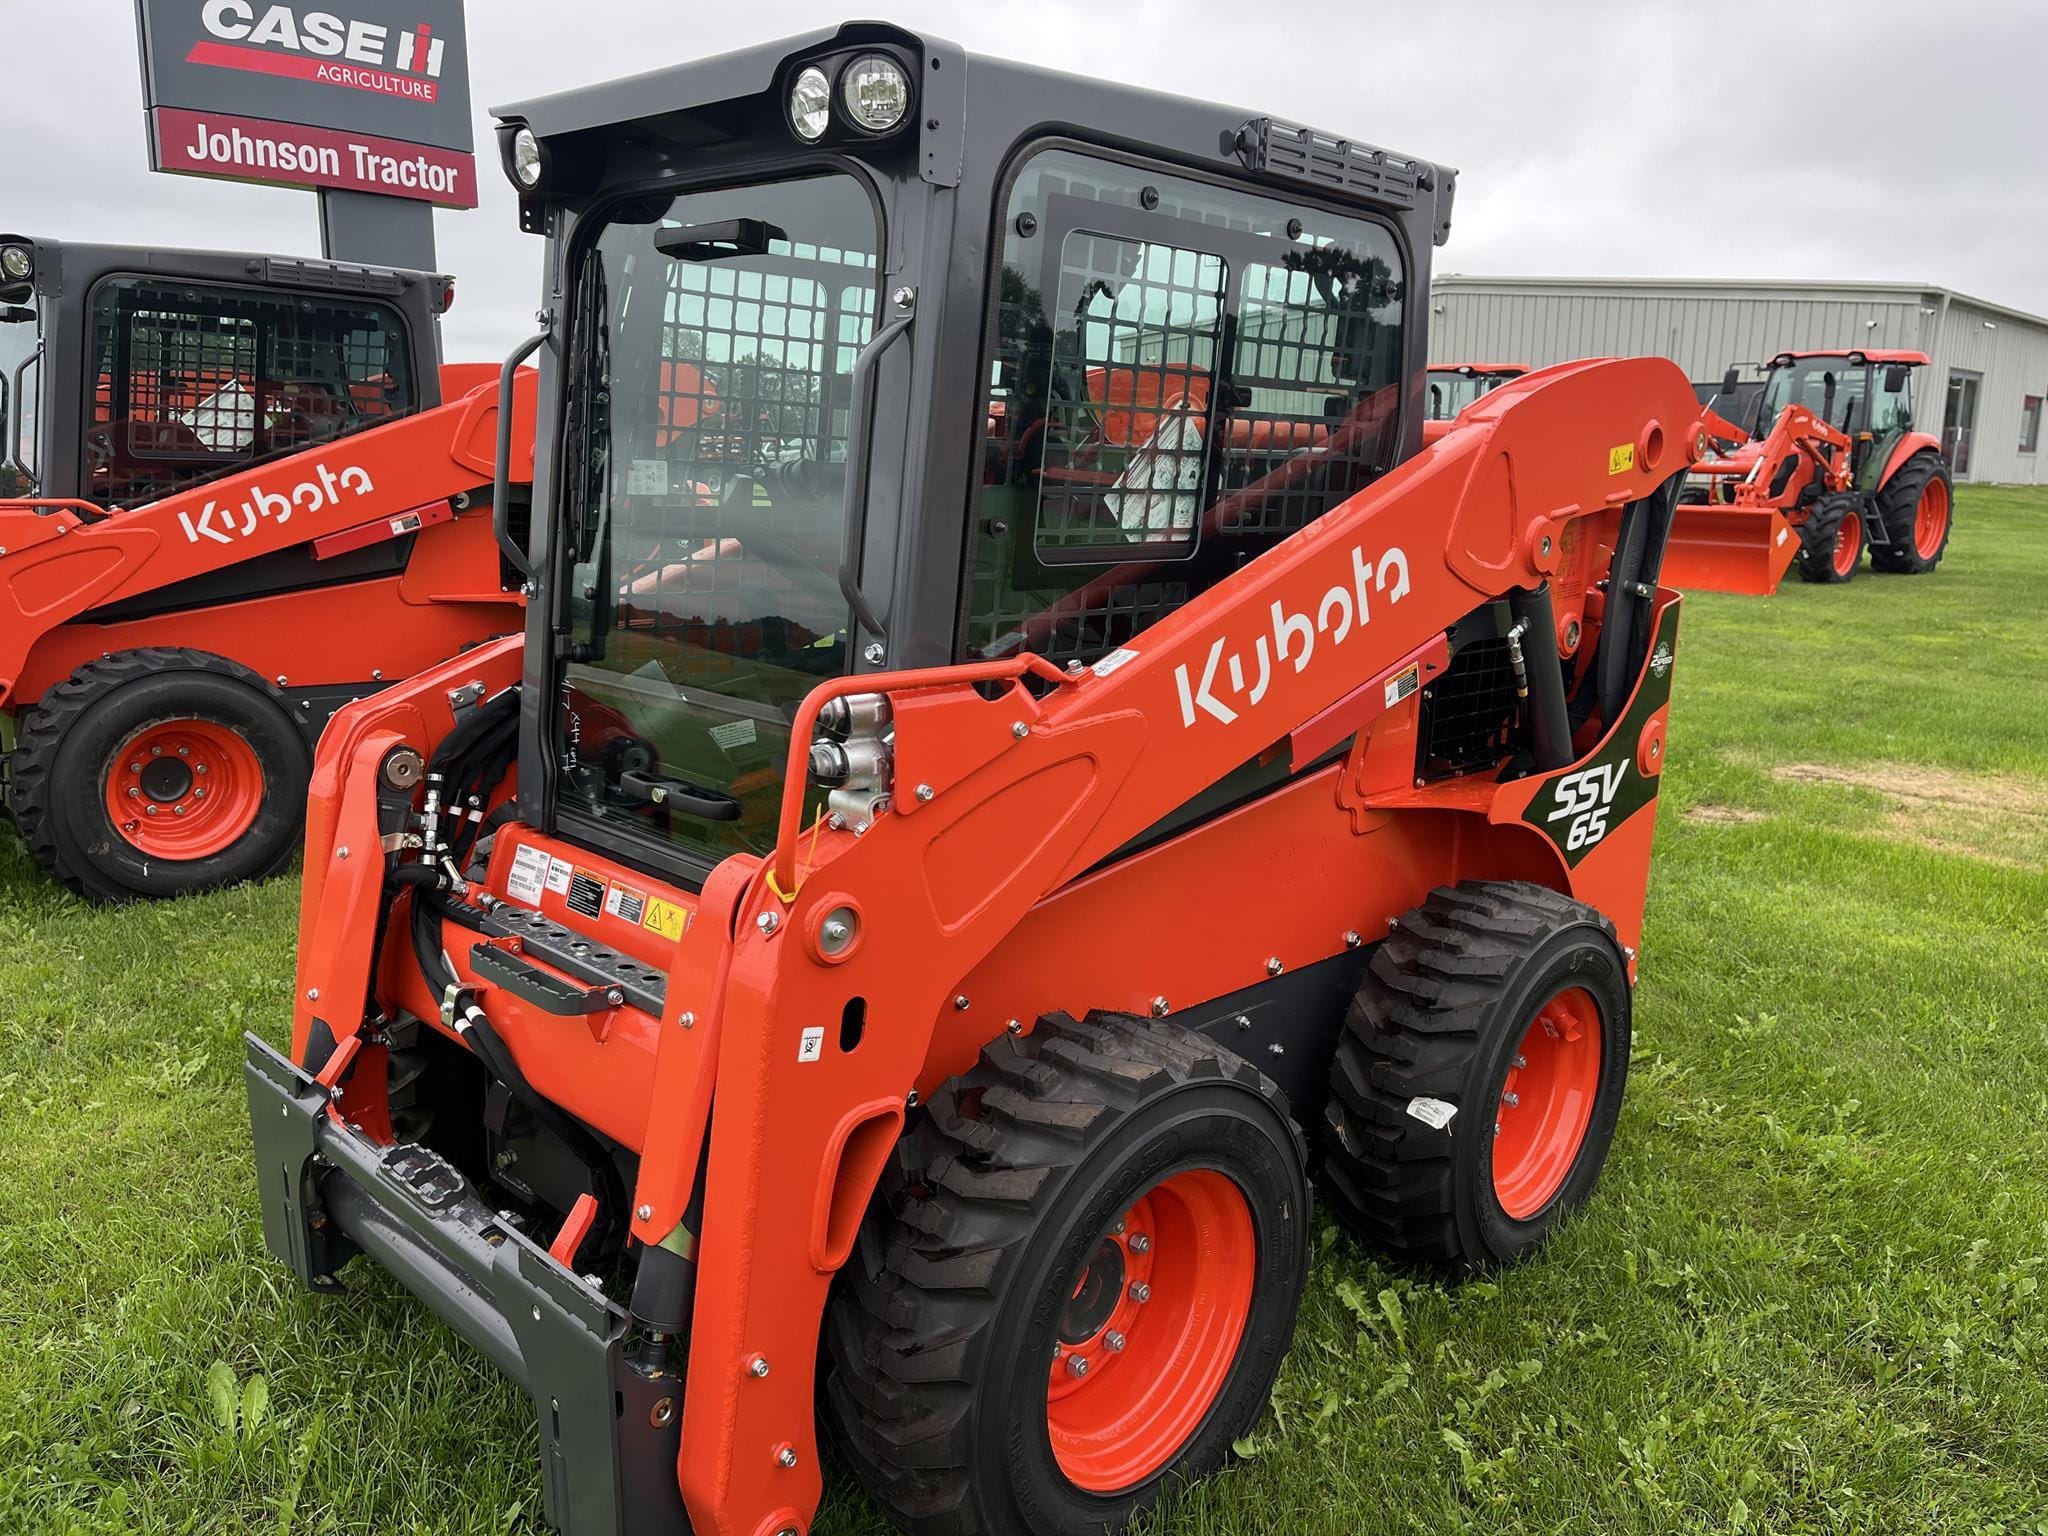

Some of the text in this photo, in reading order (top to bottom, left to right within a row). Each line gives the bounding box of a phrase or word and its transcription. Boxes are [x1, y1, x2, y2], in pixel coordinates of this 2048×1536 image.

[202, 0, 388, 65] CASE
[316, 64, 433, 100] AGRICULTURE
[187, 123, 458, 193] Johnson Tractor
[177, 463, 374, 544] Kubota
[1174, 545, 1411, 728] Kubota
[1547, 758, 1630, 822] SSV
[1567, 806, 1610, 851] 65
